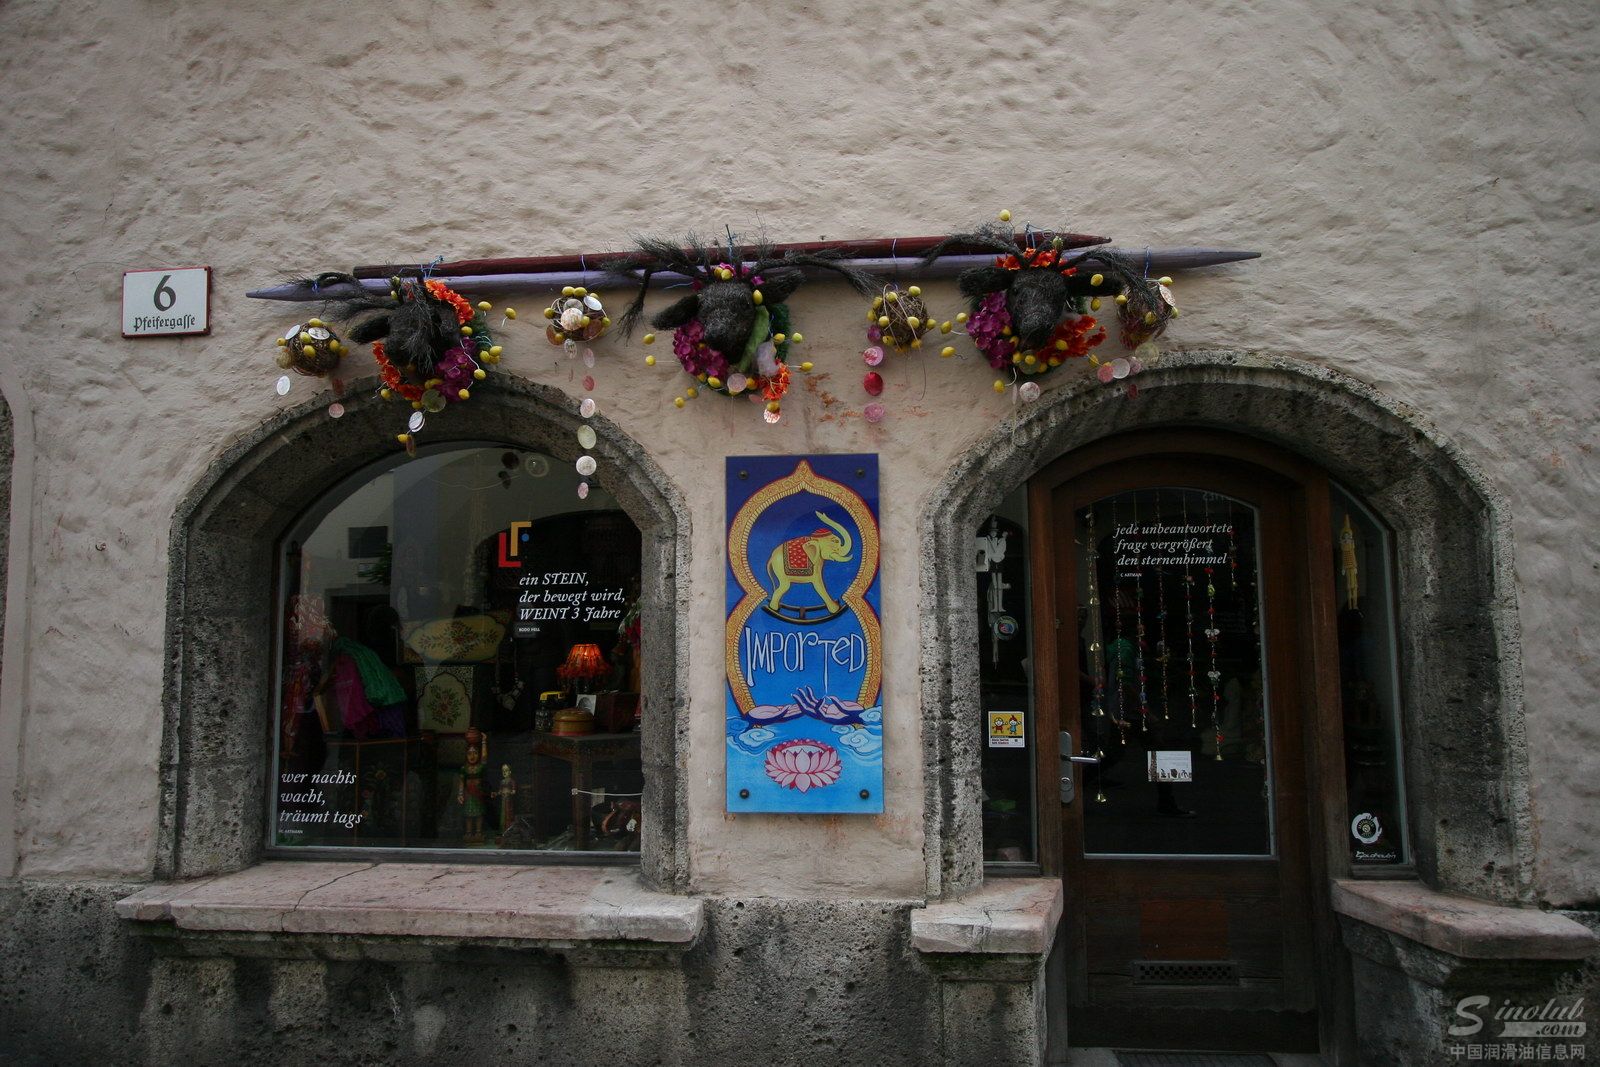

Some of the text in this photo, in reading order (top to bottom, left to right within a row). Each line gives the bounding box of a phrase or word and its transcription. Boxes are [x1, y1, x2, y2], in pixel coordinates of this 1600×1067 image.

[153, 274, 177, 312] 6
[1112, 522, 1233, 538] jede unbeantwortete
[1113, 537, 1213, 554] frage vergrößert
[1117, 552, 1228, 566] den sternenhimmel
[519, 572, 589, 587] ein STEIN,
[519, 587, 626, 606] der bewegt wird,
[519, 605, 621, 622] WEINT 3 Jahre
[281, 769, 357, 784] wer nachts
[280, 788, 326, 806] wacht,
[279, 809, 363, 829] träumt tags
